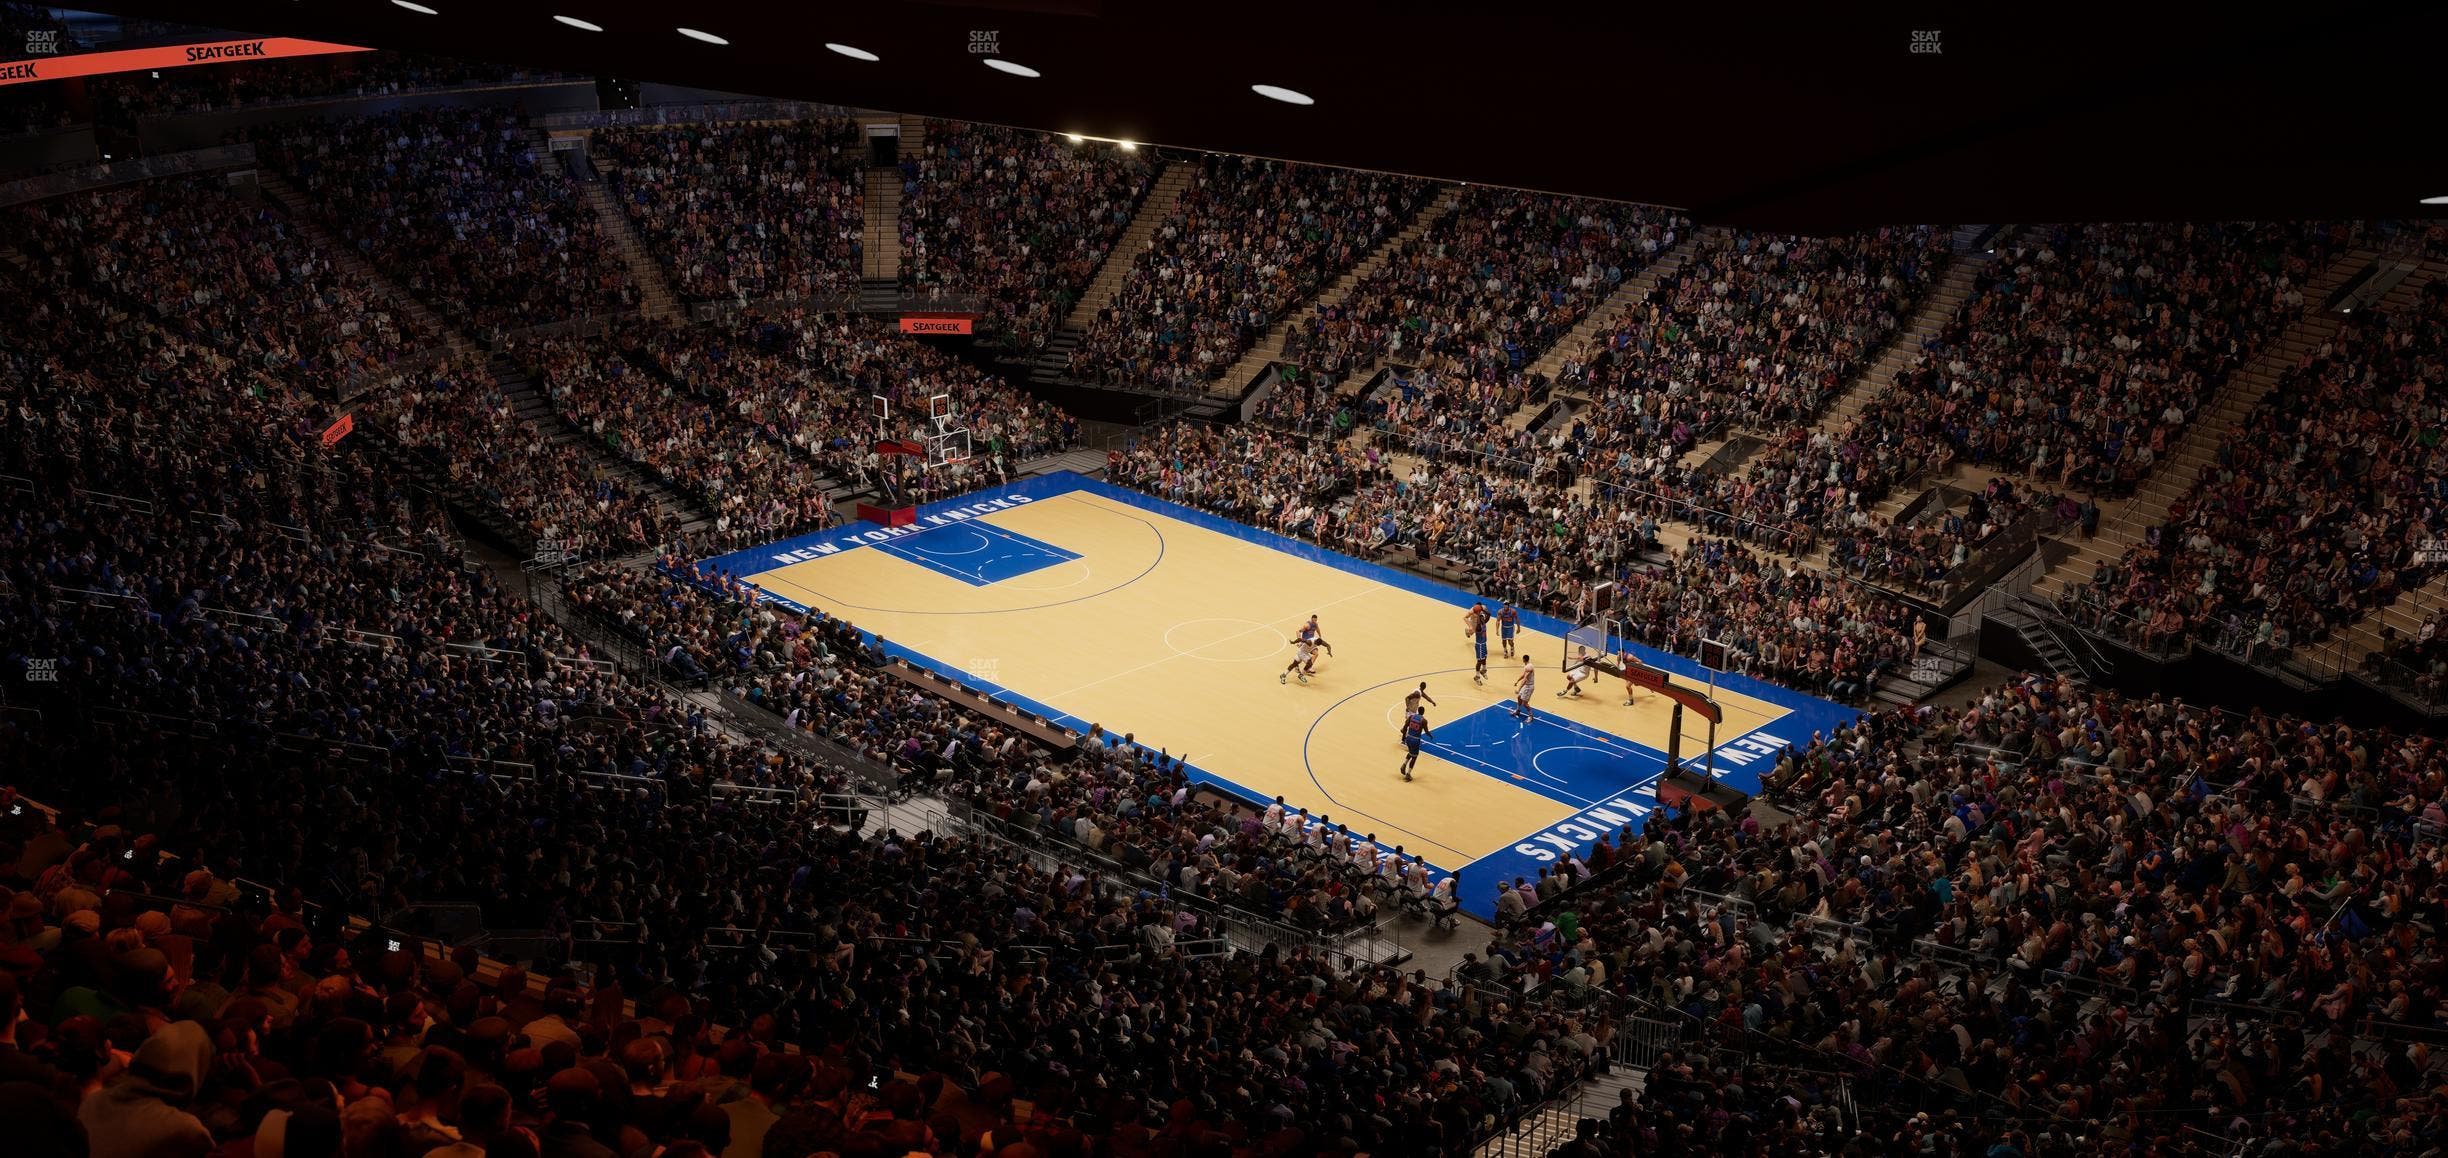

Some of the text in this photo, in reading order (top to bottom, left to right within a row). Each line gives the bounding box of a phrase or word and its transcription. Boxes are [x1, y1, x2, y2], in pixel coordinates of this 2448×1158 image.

[186, 41, 266, 62] SEATGEEK
[912, 322, 960, 332] SEATGEEK
[772, 494, 1033, 565] NEW YORK KNICKS
[1715, 731, 1792, 766] NEW
[1515, 798, 1651, 861] KNICKS
